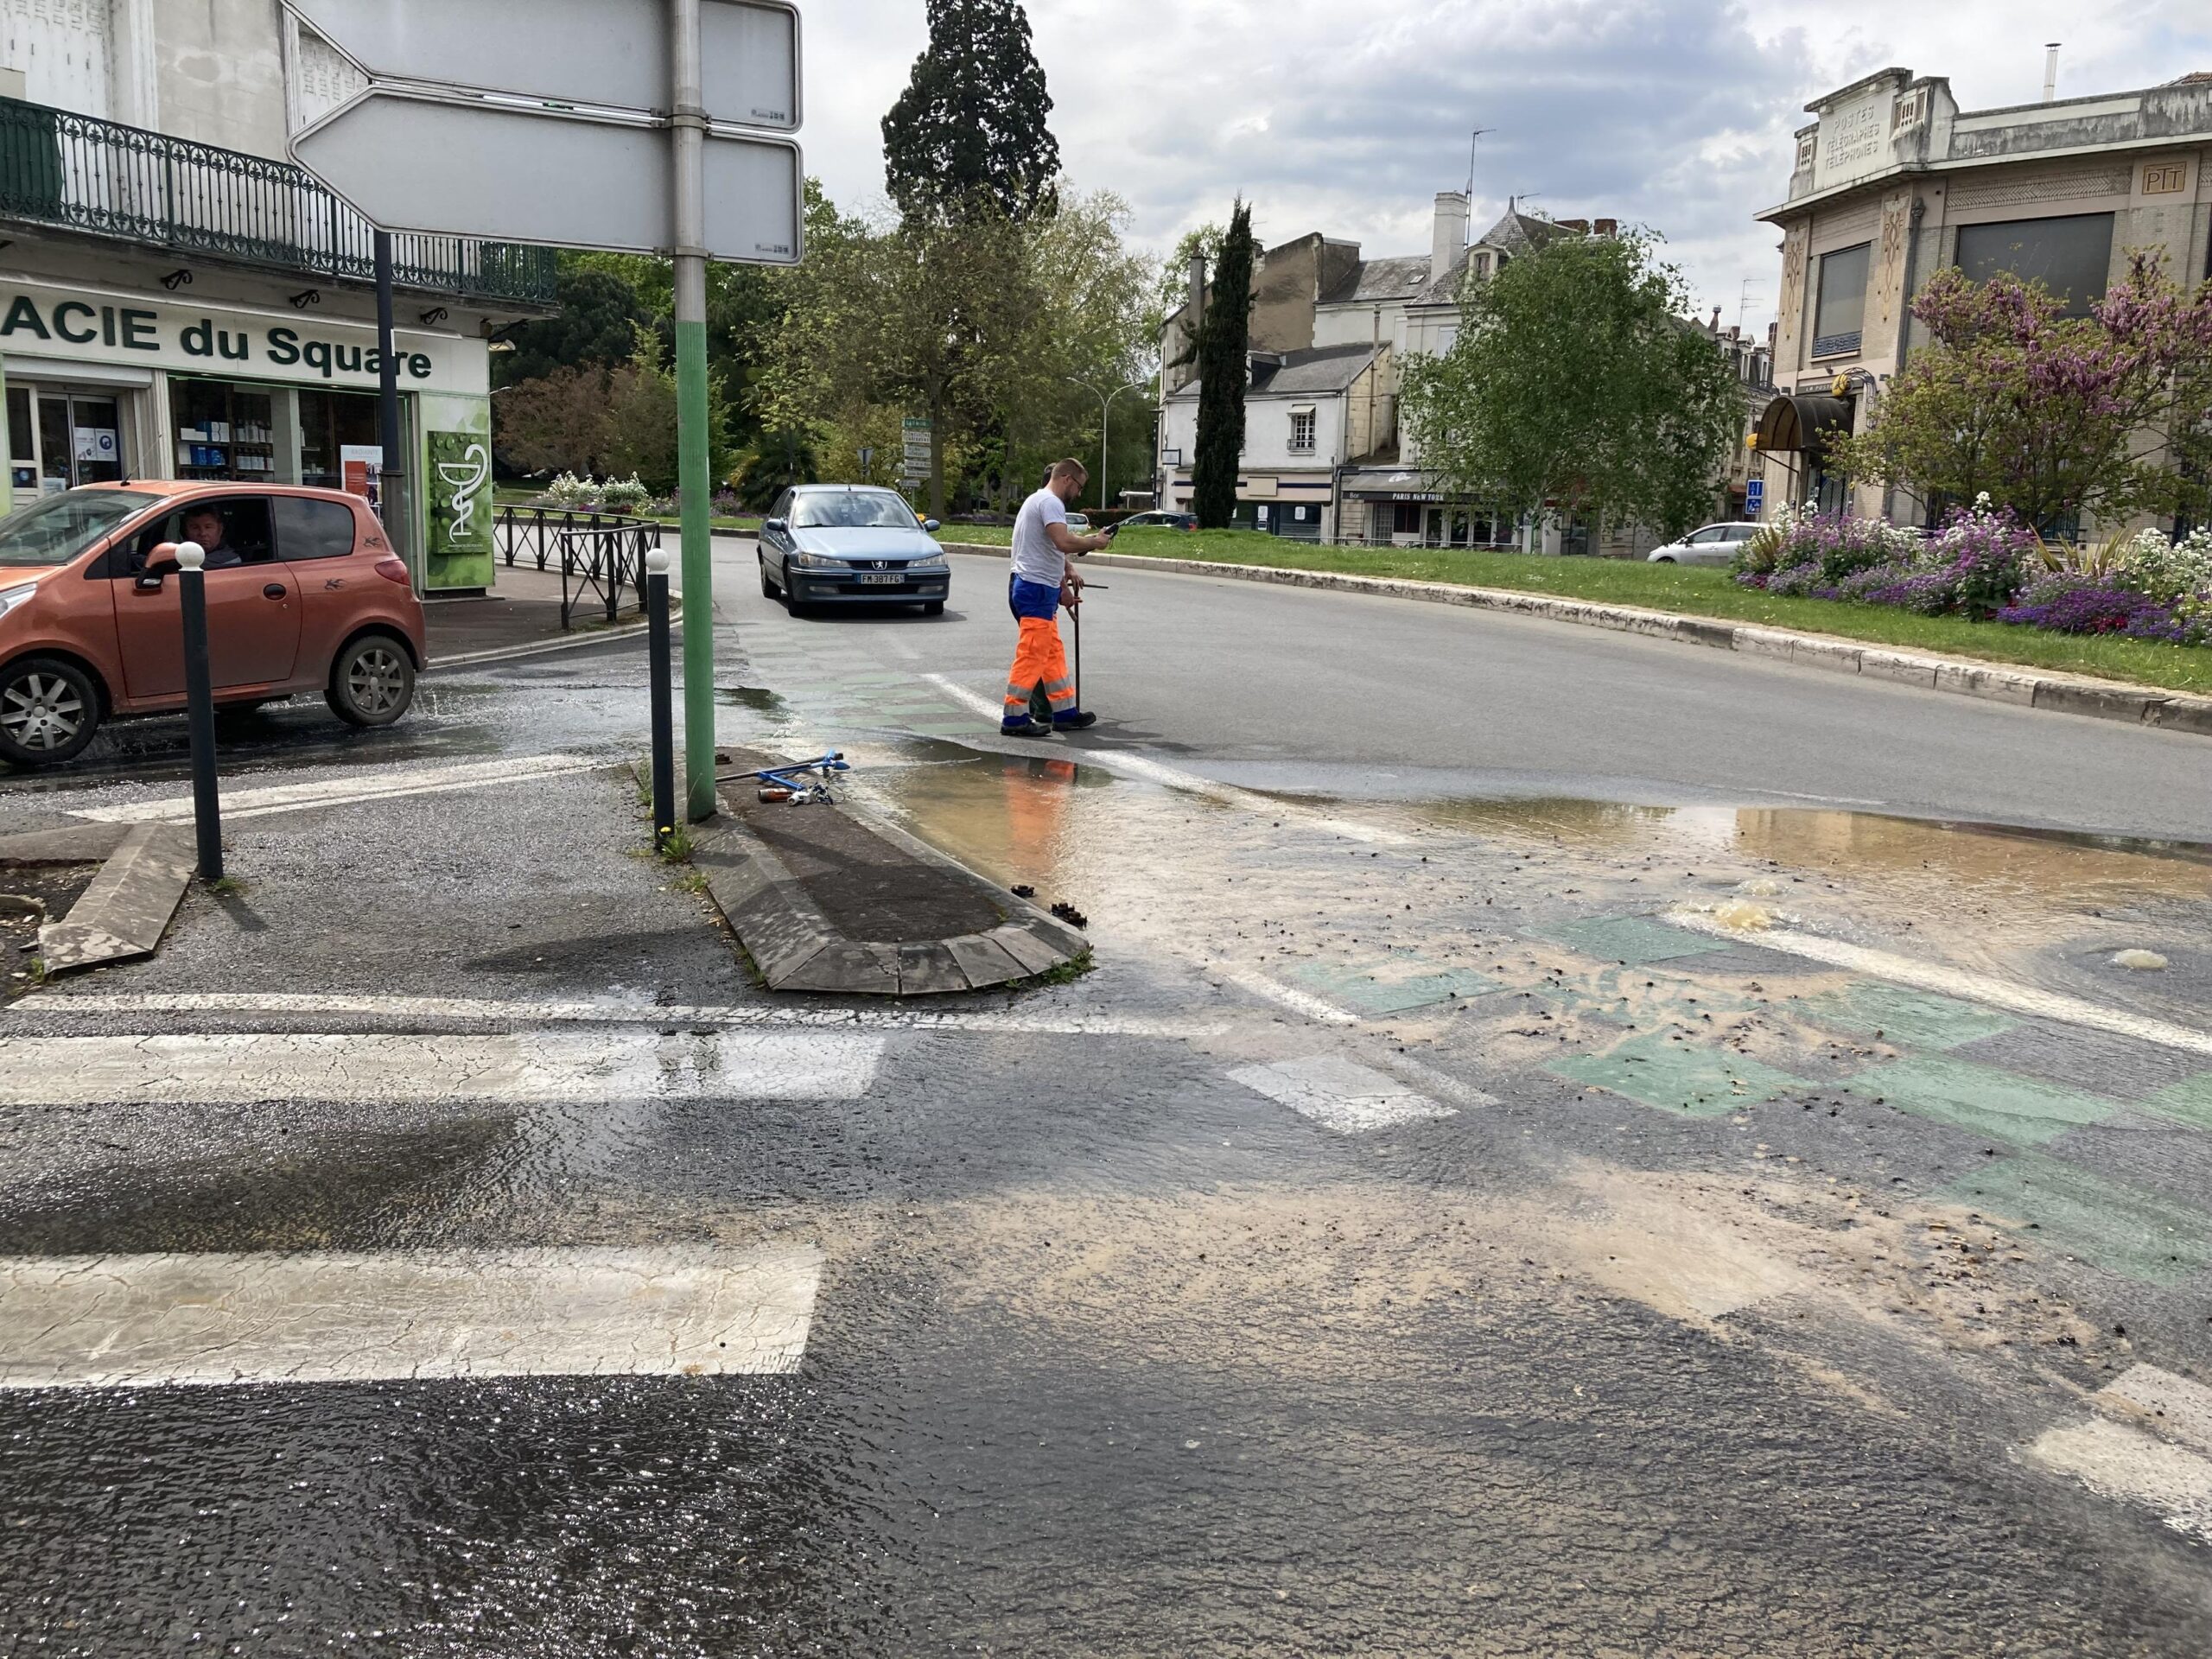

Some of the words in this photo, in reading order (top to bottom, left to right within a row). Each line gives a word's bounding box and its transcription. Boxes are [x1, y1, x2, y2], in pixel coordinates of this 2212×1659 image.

[1834, 105, 1875, 135] POSTES
[2146, 167, 2183, 192] PTT
[0, 295, 161, 351] ACIE
[180, 318, 249, 360] du
[266, 327, 432, 378] Square
